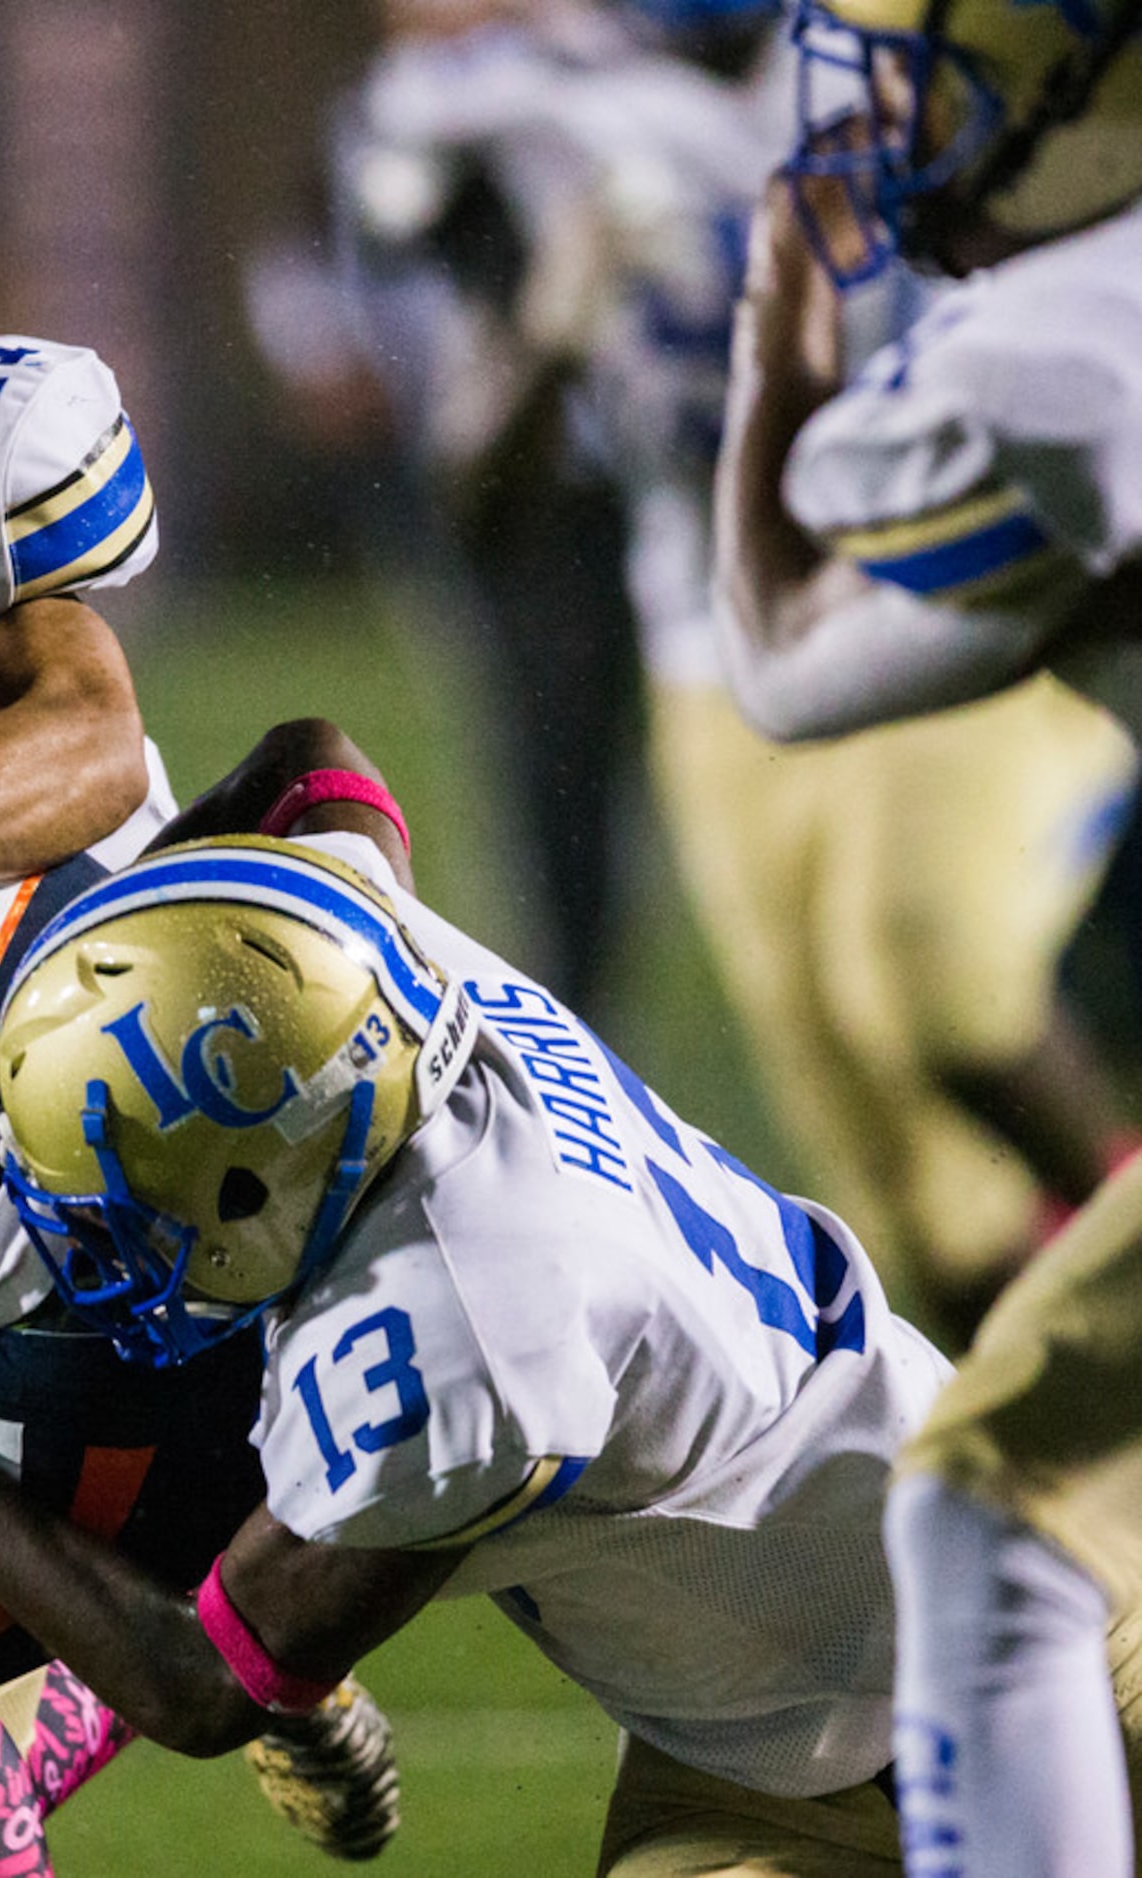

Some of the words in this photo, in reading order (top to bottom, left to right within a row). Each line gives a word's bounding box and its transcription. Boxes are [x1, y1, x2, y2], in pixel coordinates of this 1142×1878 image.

[352, 1013, 391, 1062] 13
[463, 980, 634, 1194] HARRIS
[291, 1305, 431, 1495] 13
